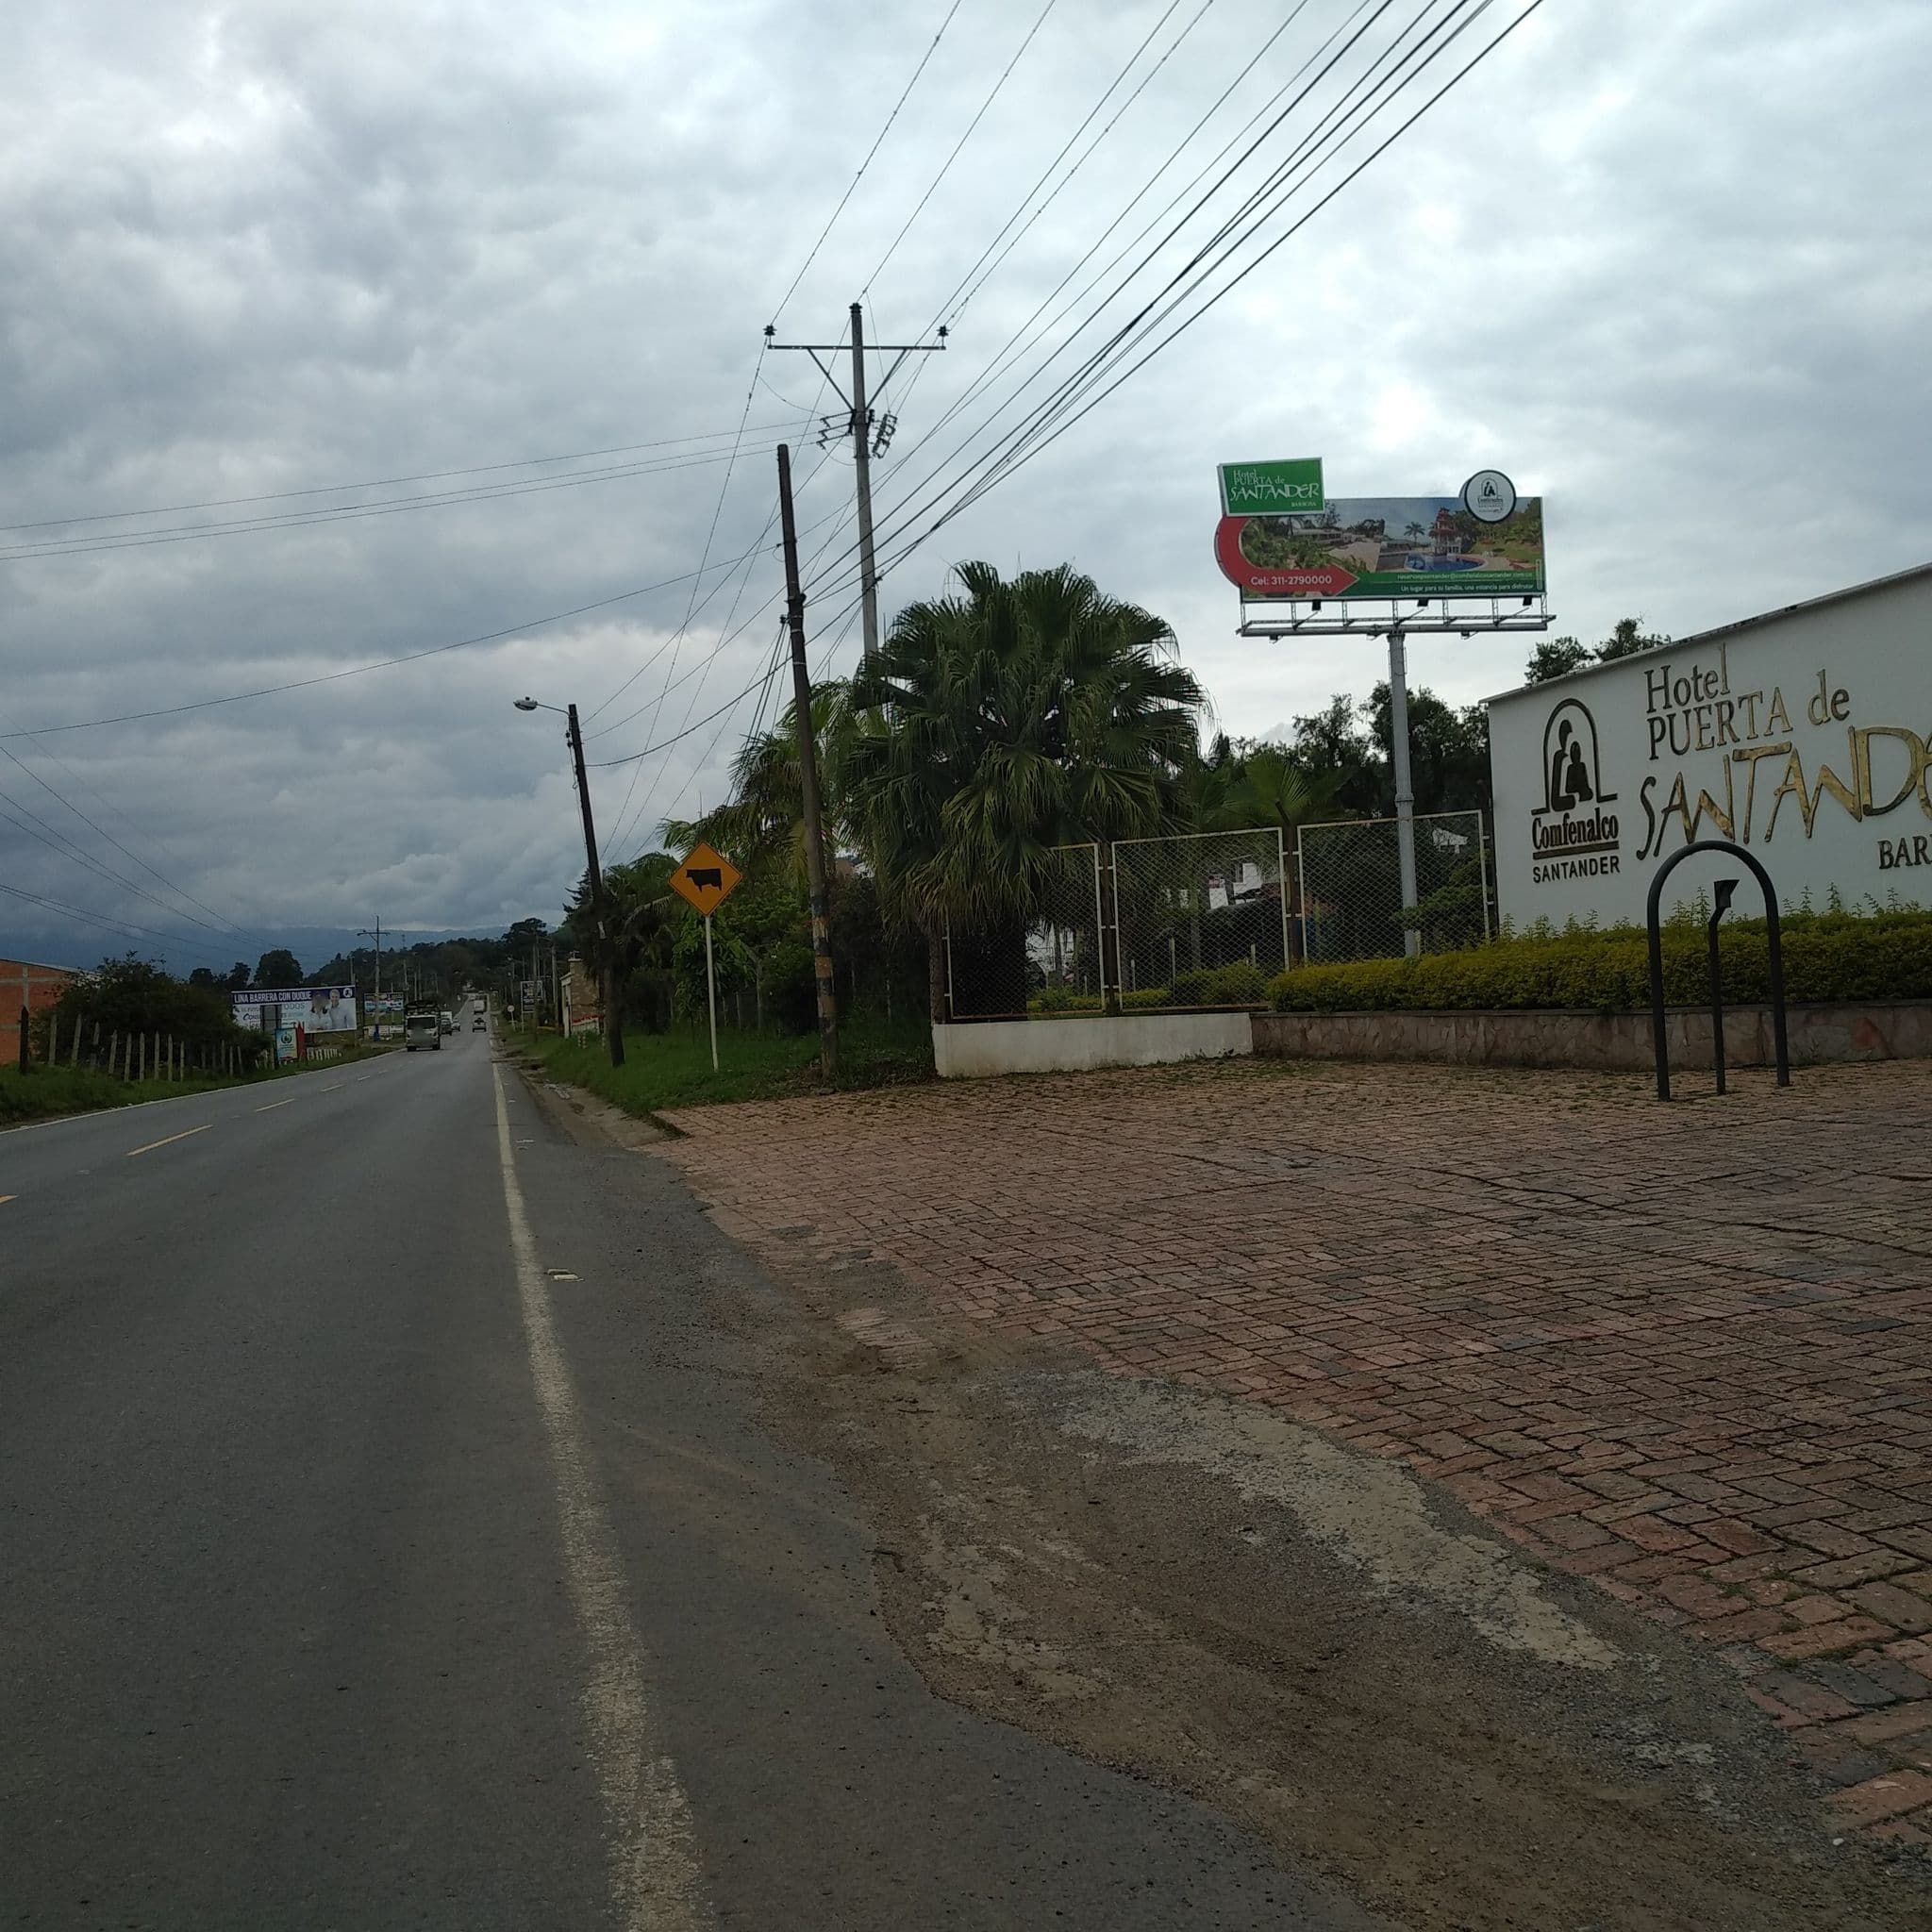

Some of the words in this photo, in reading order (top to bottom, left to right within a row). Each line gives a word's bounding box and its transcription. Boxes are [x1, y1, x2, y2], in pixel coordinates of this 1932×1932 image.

[1233, 469, 1257, 479] Hotel
[1234, 475, 1273, 486] PUERTA
[1274, 475, 1285, 484] de
[1230, 482, 1319, 502] SANTANDER
[1250, 575, 1269, 586] Cel:
[1271, 575, 1332, 586] 311-2790000
[1644, 642, 1731, 714] Hotel
[1646, 687, 1793, 760] PUERTA
[1807, 669, 1851, 725] de
[1531, 808, 1619, 850] Comfenalco
[1877, 833, 1932, 870] BAR
[1532, 855, 1621, 883] SANTANDER
[234, 993, 249, 1004] LINA
[249, 991, 277, 1003] BARRERA
[278, 991, 291, 1001] CON
[291, 991, 312, 1001] DUQUE
